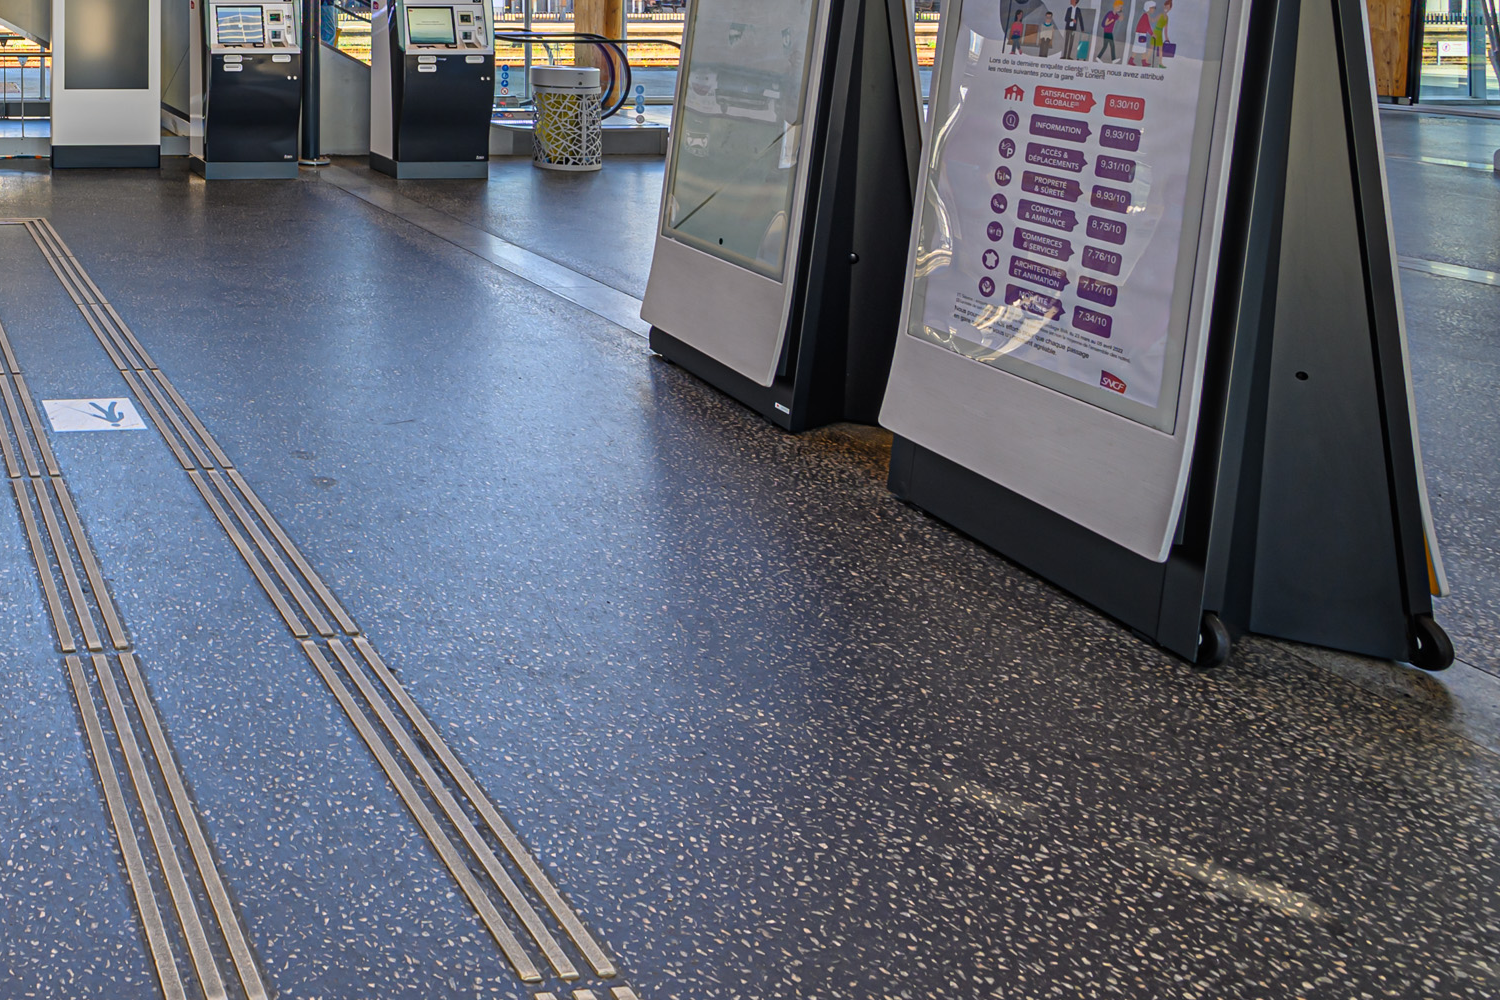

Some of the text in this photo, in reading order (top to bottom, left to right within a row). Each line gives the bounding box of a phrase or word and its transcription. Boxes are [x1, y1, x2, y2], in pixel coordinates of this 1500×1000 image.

[1013, 69, 1039, 77] suivantes
[1061, 73, 1074, 81] gare
[1085, 71, 1105, 80] Lorient
[1017, 60, 1039, 68] dernière
[1140, 72, 1164, 81] attribué
[1041, 89, 1086, 101] SATISFACTION
[1109, 99, 1140, 111] 8,30/10
[1035, 121, 1082, 135] INFORMATION
[1105, 129, 1135, 141] 8,93/10
[1041, 147, 1068, 159] ACCÈS &
[1028, 153, 1079, 171] DÉPLACEMENTS
[1100, 159, 1131, 173] 9,31/10
[1034, 176, 1067, 189] PROPRETÉ
[1041, 185, 1065, 198] SÛRETÉ
[1096, 190, 1126, 204] 8,93/10
[1031, 204, 1063, 217] CONFORT
[1031, 213, 1066, 228] AMBIANCE
[1091, 220, 1122, 234] 8,75/10
[1021, 231, 1063, 248] COMMERCES
[1029, 242, 1059, 257] SERVICES
[1087, 249, 1117, 264] 7,76/10
[1014, 260, 1062, 279] ARCHITECTURE
[1014, 268, 1060, 288] ET ANIMATION
[1083, 280, 1113, 296] 7,17/10
[954, 305, 966, 314] Nous
[1078, 310, 1107, 327] 7,34/10
[1035, 335, 1090, 359] que chaque passage
[1101, 377, 1125, 390] SNCF
